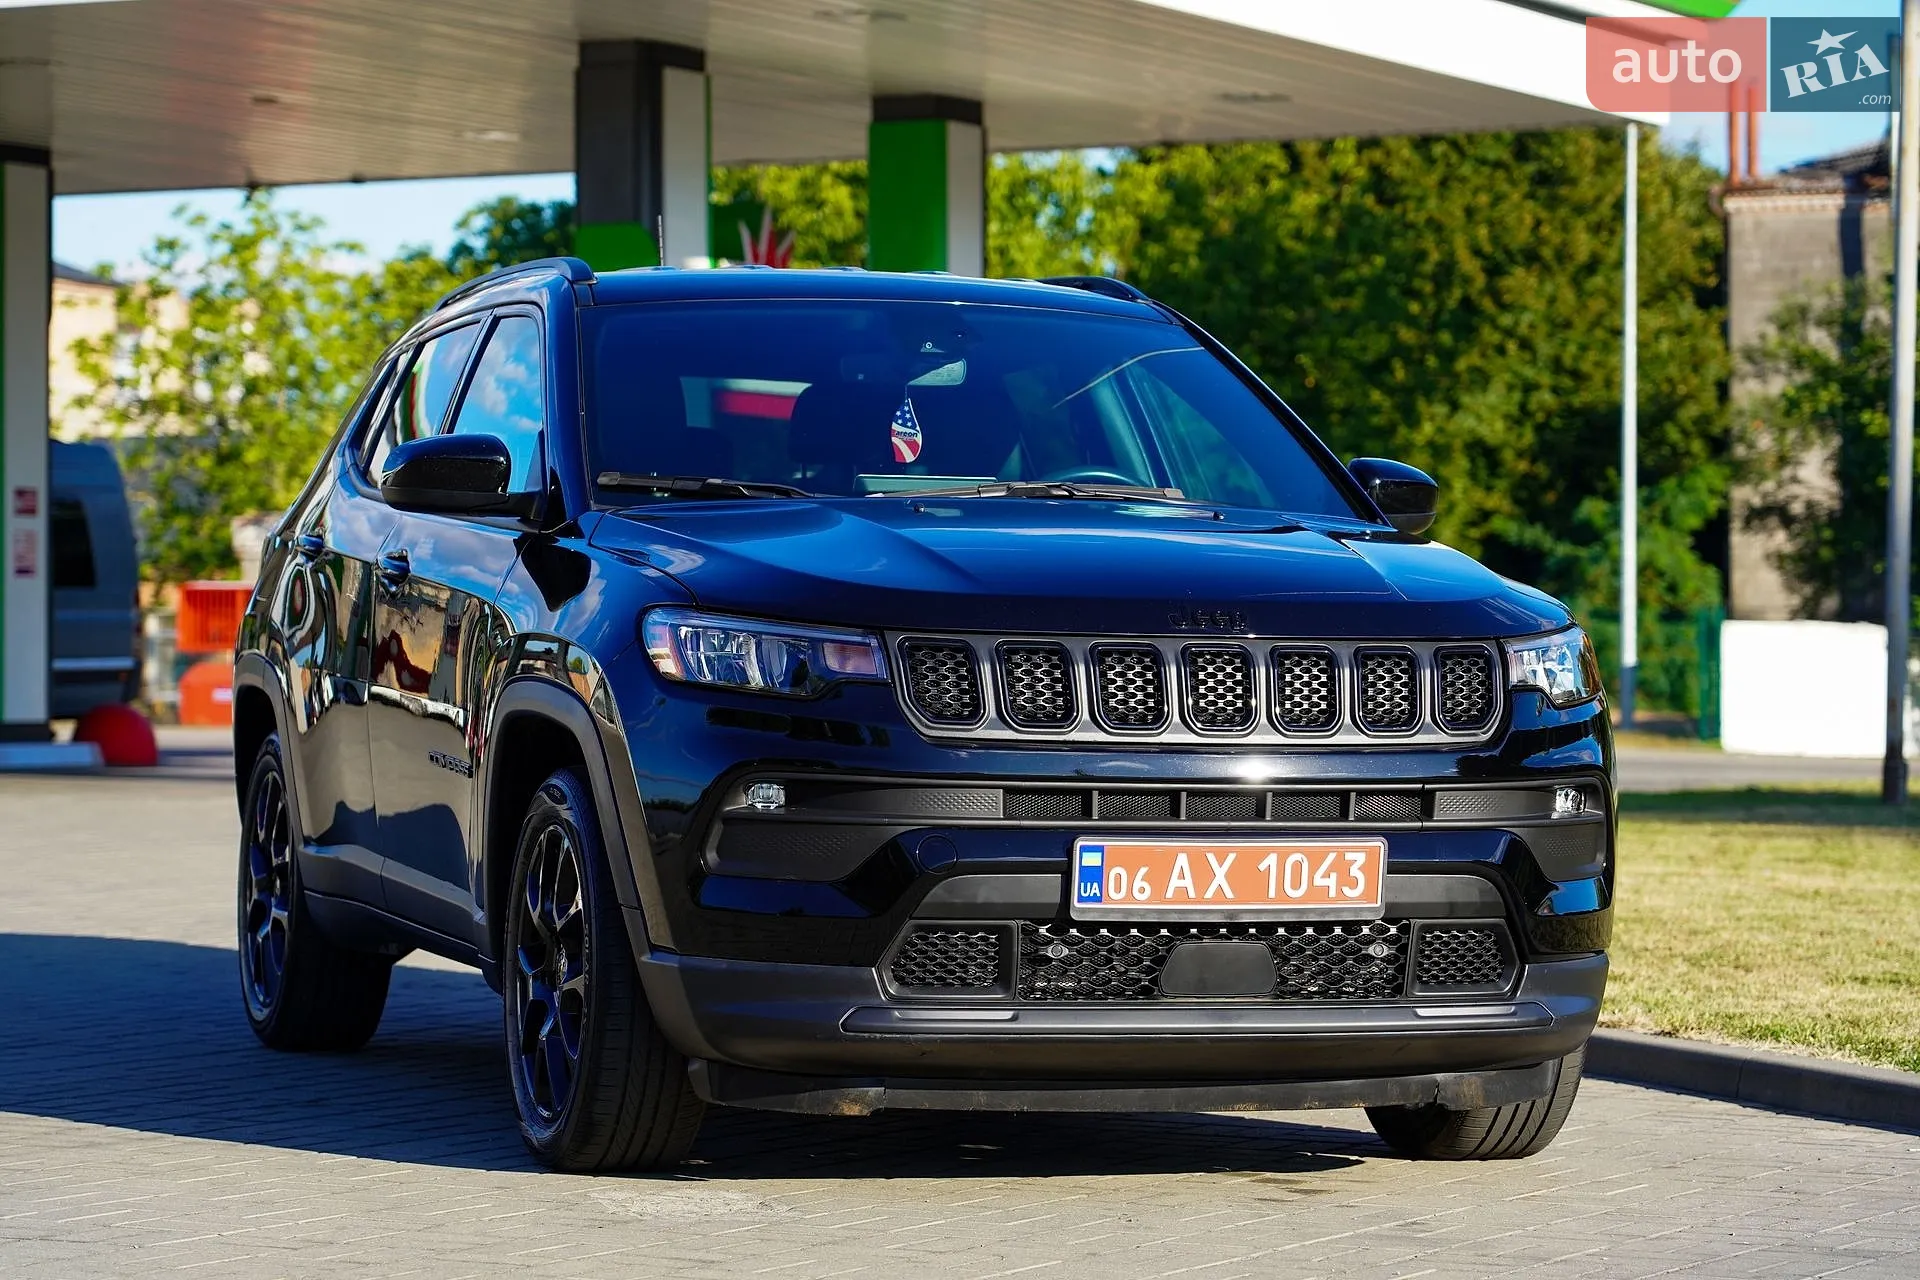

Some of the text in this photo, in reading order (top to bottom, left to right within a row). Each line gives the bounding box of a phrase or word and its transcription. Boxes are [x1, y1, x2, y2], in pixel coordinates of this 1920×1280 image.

[1080, 882, 1100, 897] UA
[1107, 852, 1367, 900] 06 AX 1043
